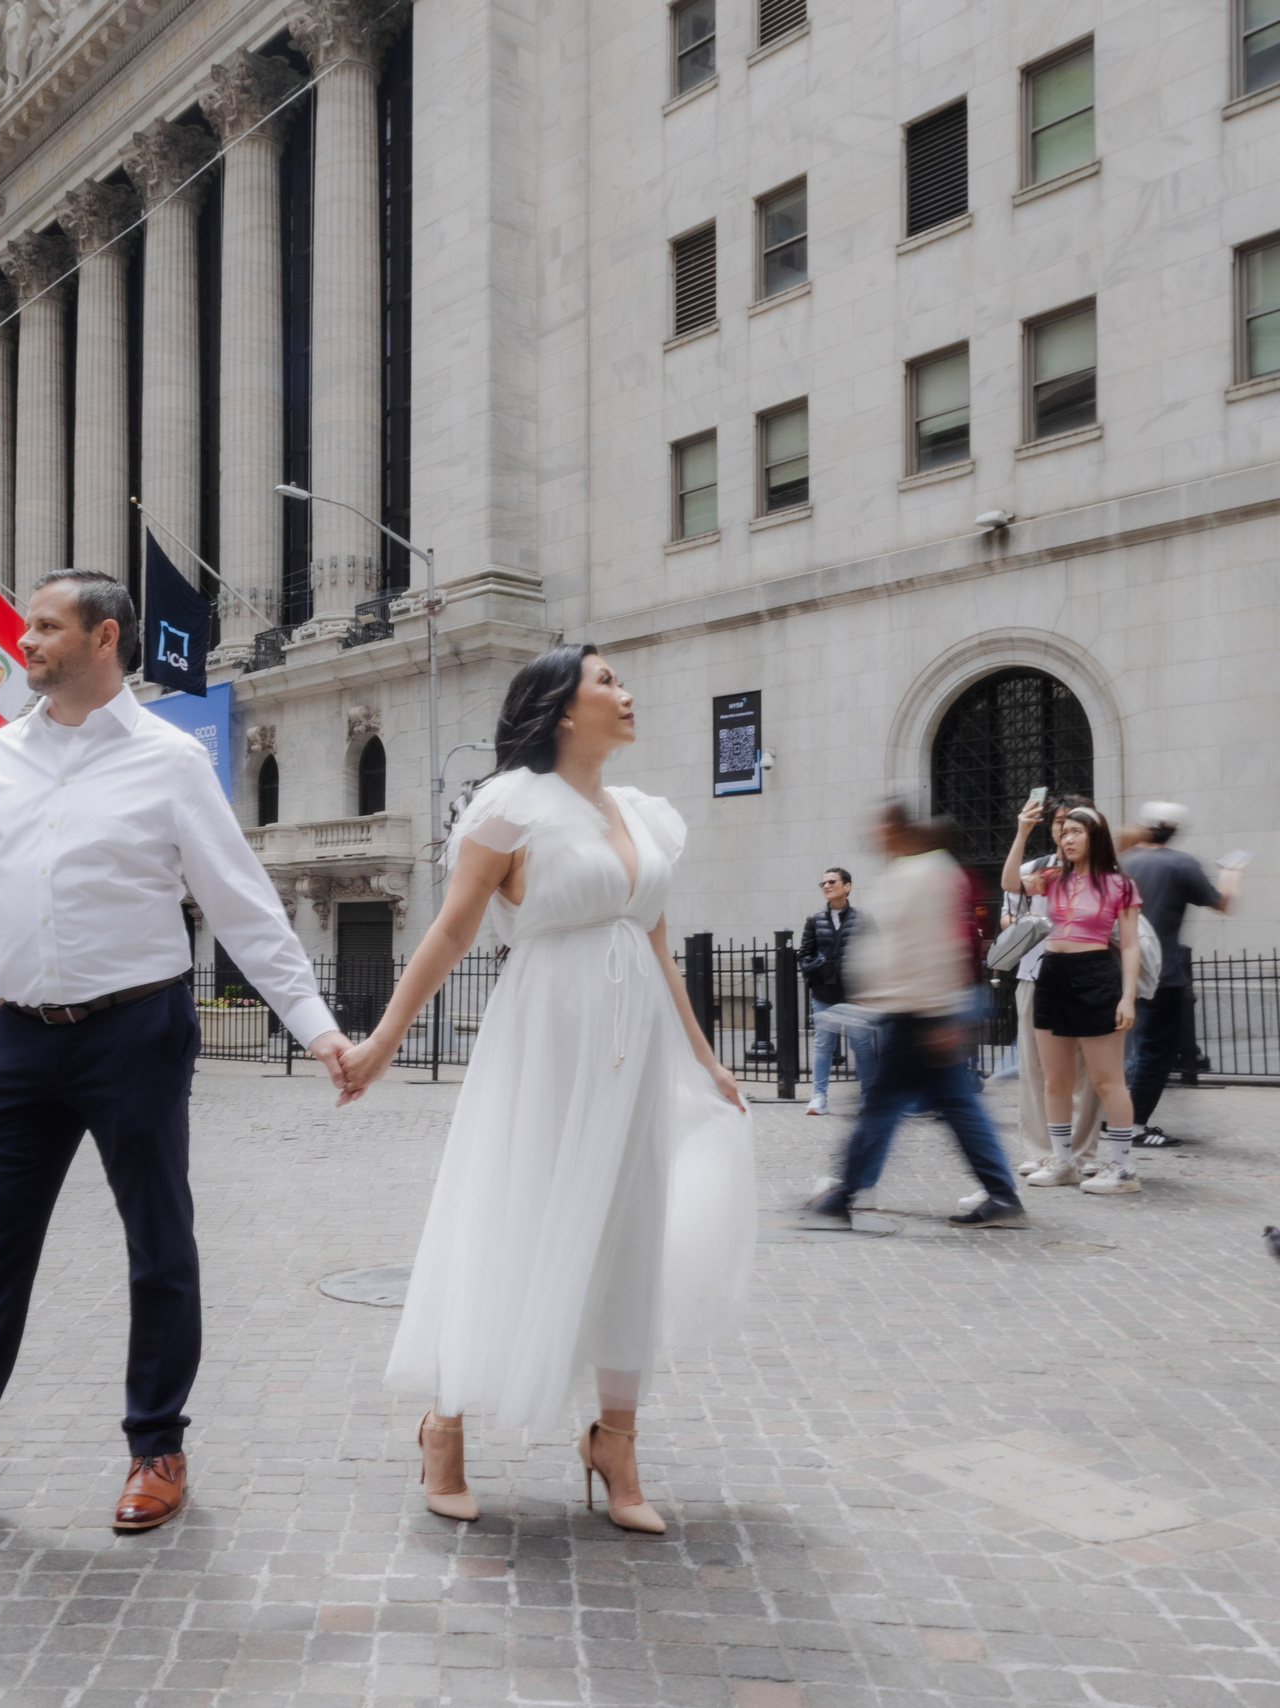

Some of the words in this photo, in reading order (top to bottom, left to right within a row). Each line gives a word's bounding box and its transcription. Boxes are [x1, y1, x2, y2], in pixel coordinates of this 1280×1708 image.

[17, 166, 40, 201] NEW
[48, 126, 83, 171] YORK
[90, 81, 134, 135] STOCK
[143, 0, 230, 89] EXCHANGE
